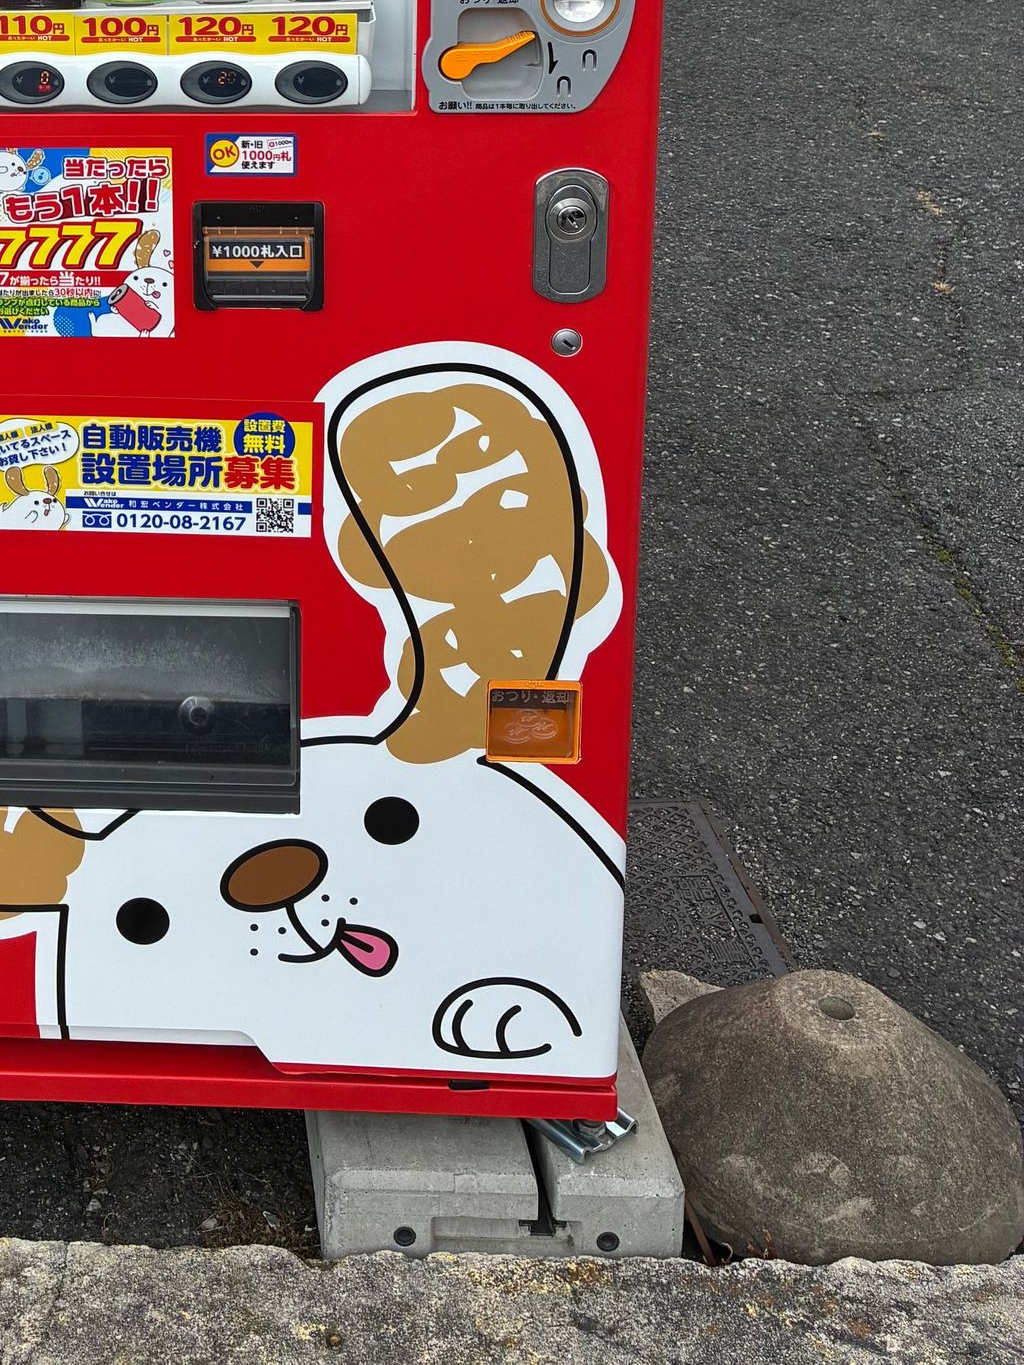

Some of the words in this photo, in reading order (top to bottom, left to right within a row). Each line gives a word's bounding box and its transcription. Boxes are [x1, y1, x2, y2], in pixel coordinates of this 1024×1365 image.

[81, 17, 159, 36] 100円
[174, 16, 254, 36] 120円
[271, 16, 348, 36] 120円
[212, 145, 236, 161] OK
[241, 140, 264, 149] 新・旧
[241, 161, 276, 170] 使えます
[242, 150, 292, 162] 1000円札
[64, 156, 170, 180] 当たったら
[3, 178, 160, 224] もう1本!!
[211, 244, 303, 259] ¥1000札入口
[242, 418, 287, 434] 設置費
[81, 423, 223, 453] 自動販売機
[243, 433, 287, 454] 無料
[80, 454, 296, 491] 設置場所募集
[128, 499, 244, 512] 和宏ベンダー株式会社
[116, 511, 247, 532] 0120-08-2167
